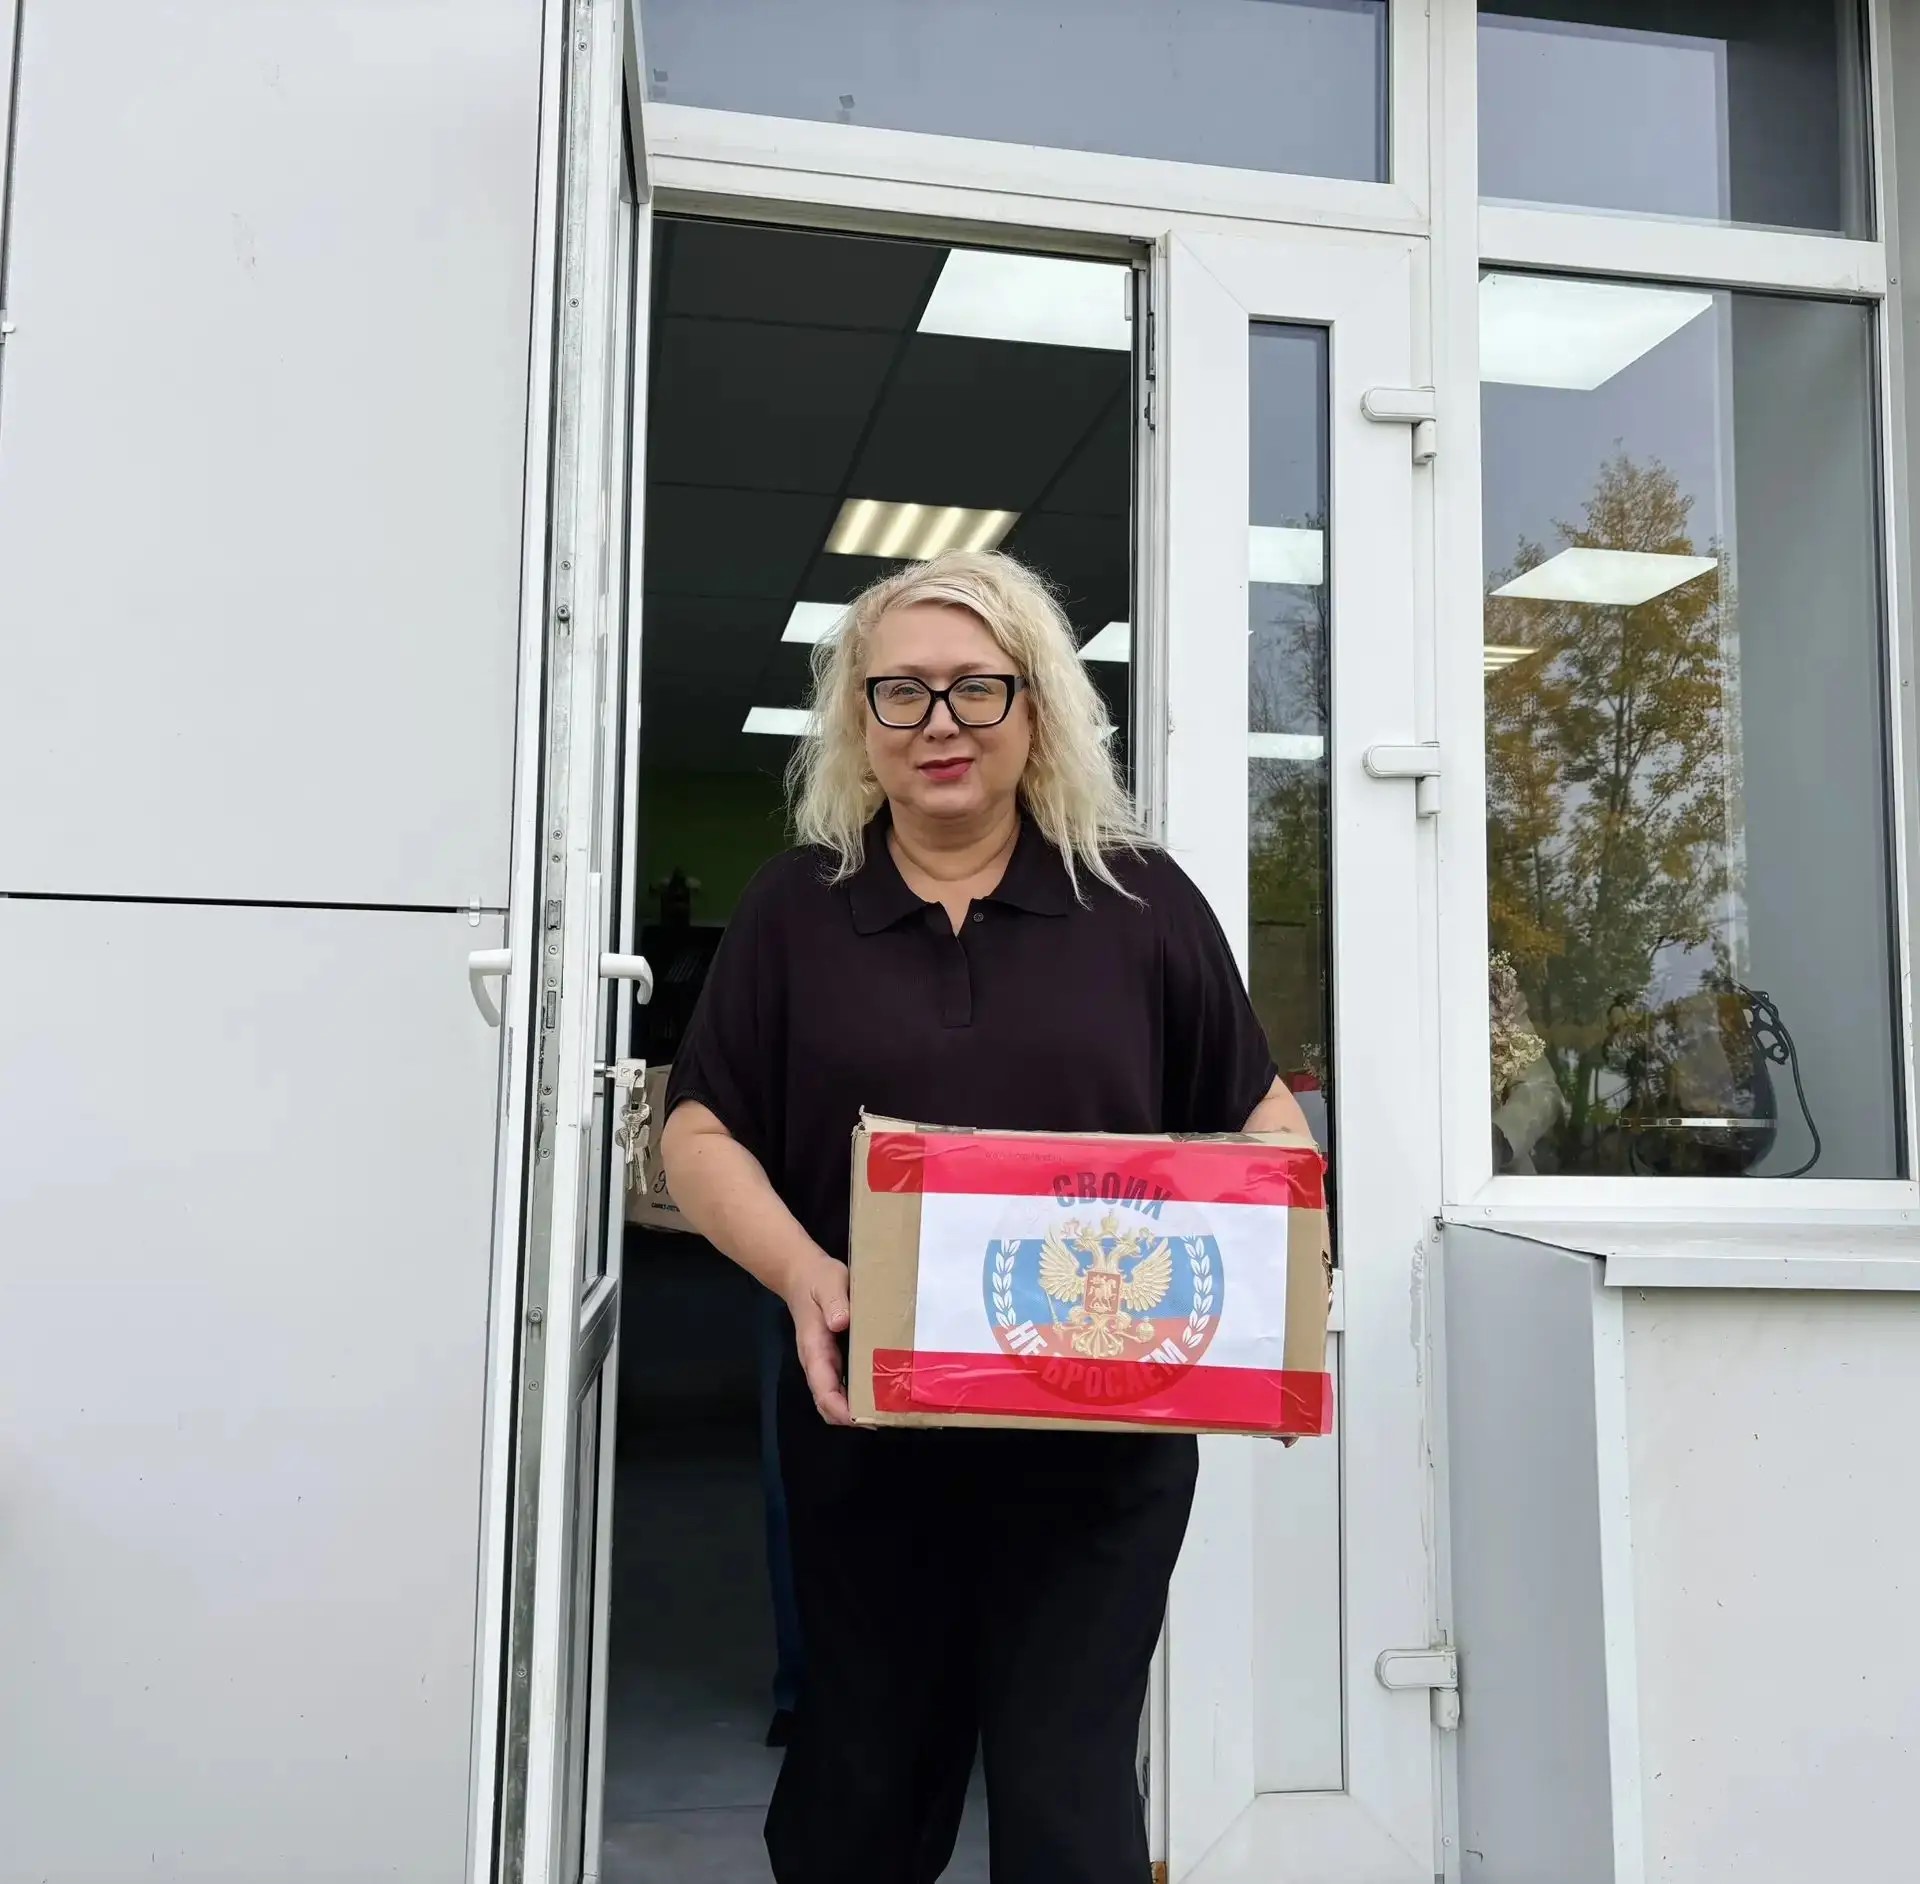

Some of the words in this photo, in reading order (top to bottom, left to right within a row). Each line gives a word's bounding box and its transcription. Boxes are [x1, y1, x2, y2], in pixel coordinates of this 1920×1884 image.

[1052, 1172, 1174, 1220] СВОИХ
[1004, 1319, 1048, 1365] НЕ
[1041, 1337, 1189, 1398] БРОСАЕМ
